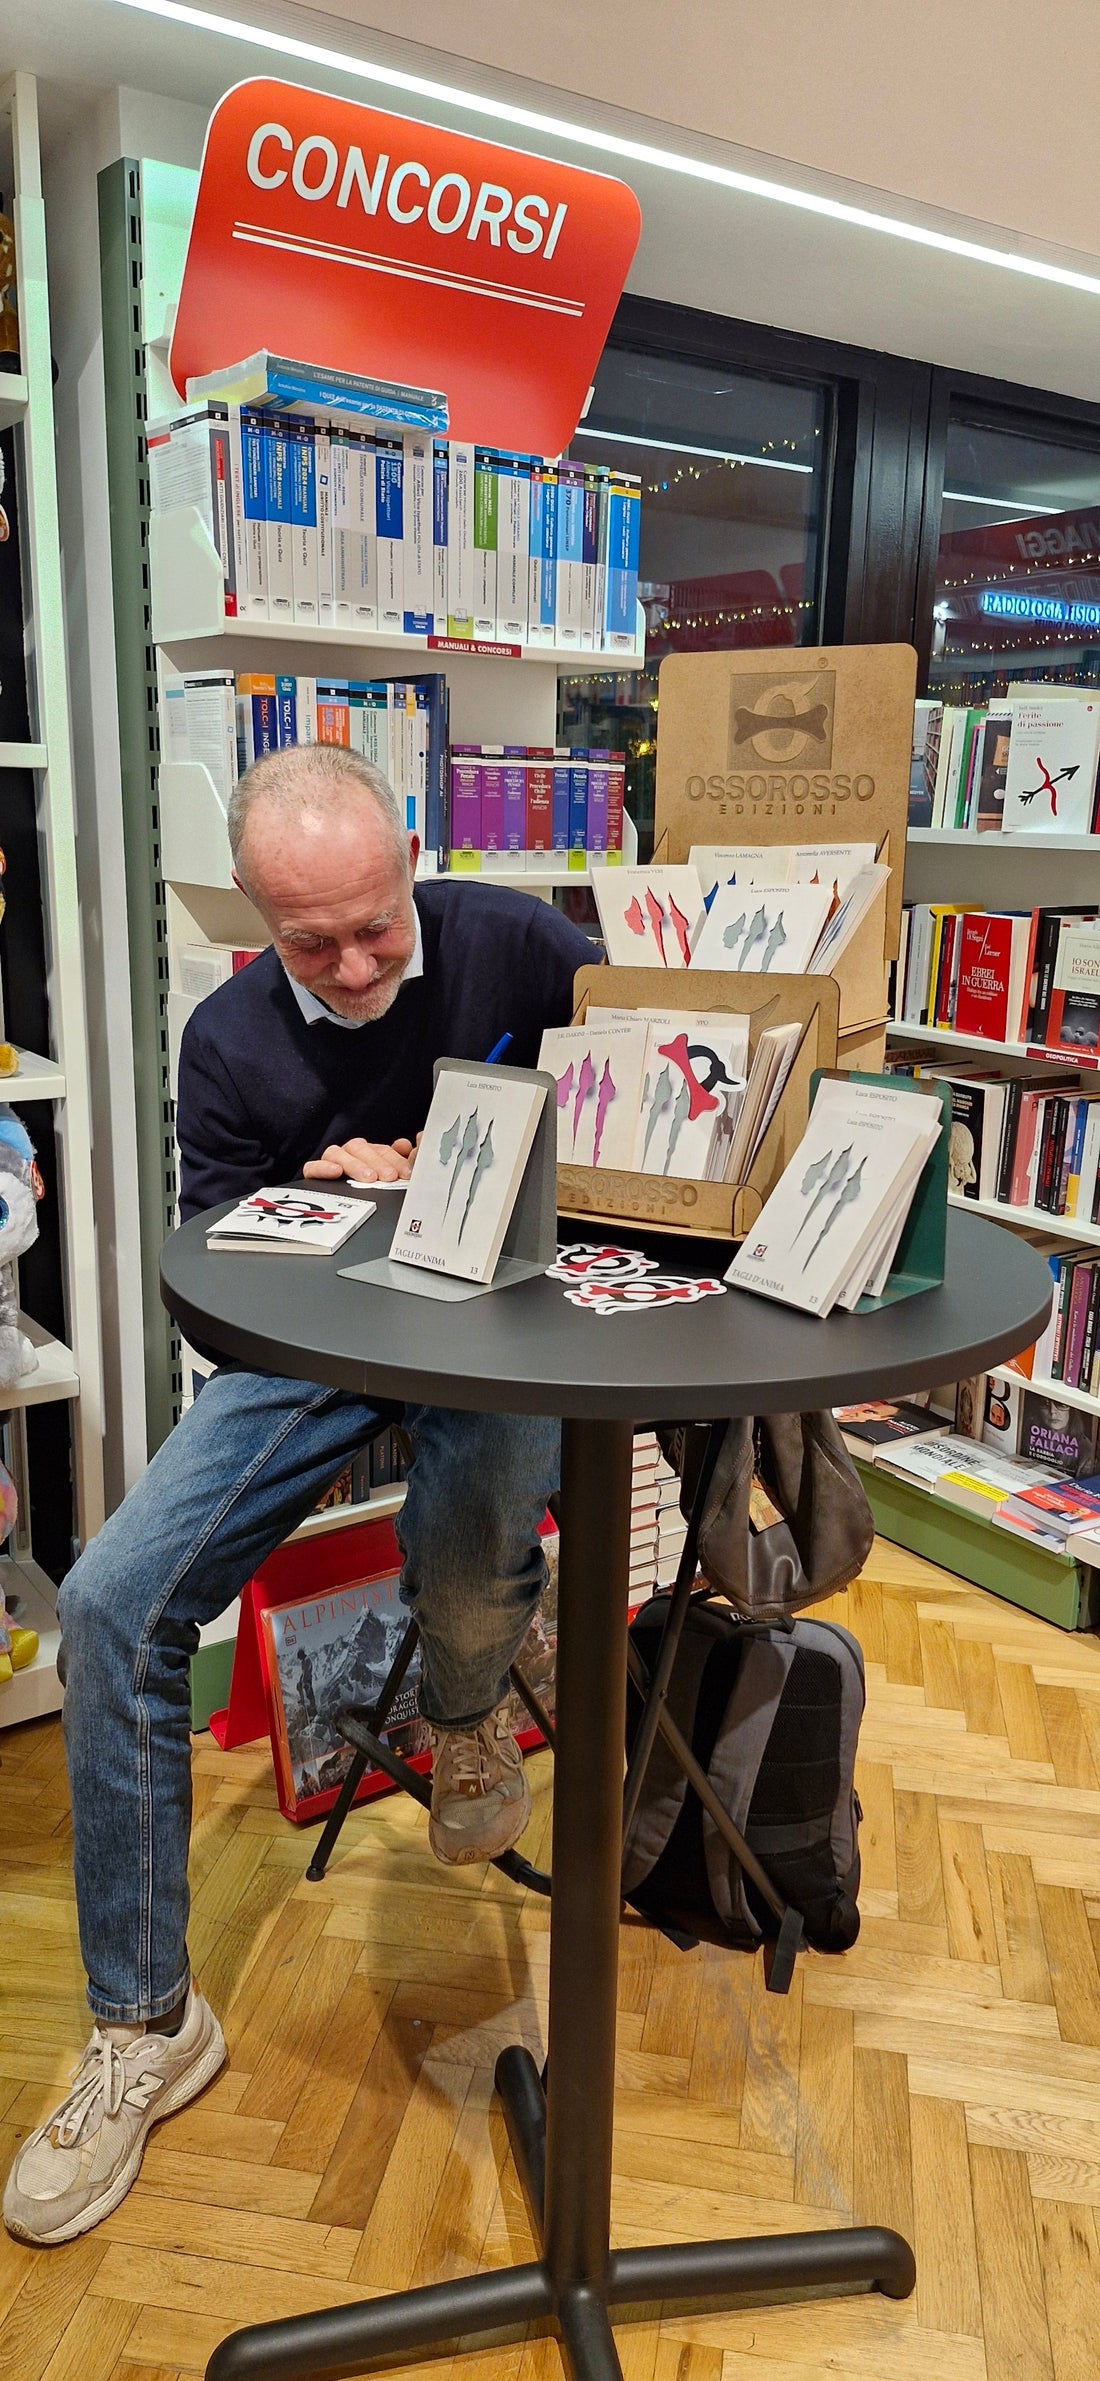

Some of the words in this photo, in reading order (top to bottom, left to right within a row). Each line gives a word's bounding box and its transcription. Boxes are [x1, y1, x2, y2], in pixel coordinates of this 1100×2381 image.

[246, 122, 569, 260] CONCORSI
[335, 376, 344, 384] PER
[353, 380, 374, 390] PATENTE
[983, 594, 1064, 619] RADIOLOGIA
[438, 641, 469, 650] MANUALI
[478, 646, 512, 655] CONCORSI
[685, 774, 876, 801] OSSOROSSO
[719, 804, 836, 815] EDIZIONI
[1072, 957, 1081, 965] IO
[971, 966, 995, 979] EBREI
[961, 975, 970, 985] IN
[971, 977, 1004, 992] GUERRA
[1045, 1053, 1078, 1064] GEOPOLITICA
[478, 1083, 502, 1092] ESPOSITO
[869, 1092, 897, 1102] ESPOSITO
[858, 1120, 883, 1130] ESPOSITO
[569, 1193, 665, 1215] EDIZIONI
[394, 1247, 415, 1261] TAGLI
[414, 1252, 446, 1267] D'ANIMA
[469, 1266, 478, 1275] 13
[732, 1269, 752, 1282] TAGLI
[751, 1274, 784, 1292] D'ANIMA
[808, 1295, 818, 1304] 13
[1031, 1425, 1078, 1447] ORIANA
[1030, 1436, 1078, 1457] FALLACI
[1036, 1447, 1054, 1457] RABBIA
[912, 1444, 966, 1470] MONDIALE
[283, 1582, 394, 1634] ALPINIST
[468, 1784, 477, 1792] N
[124, 2069, 164, 2109] N
